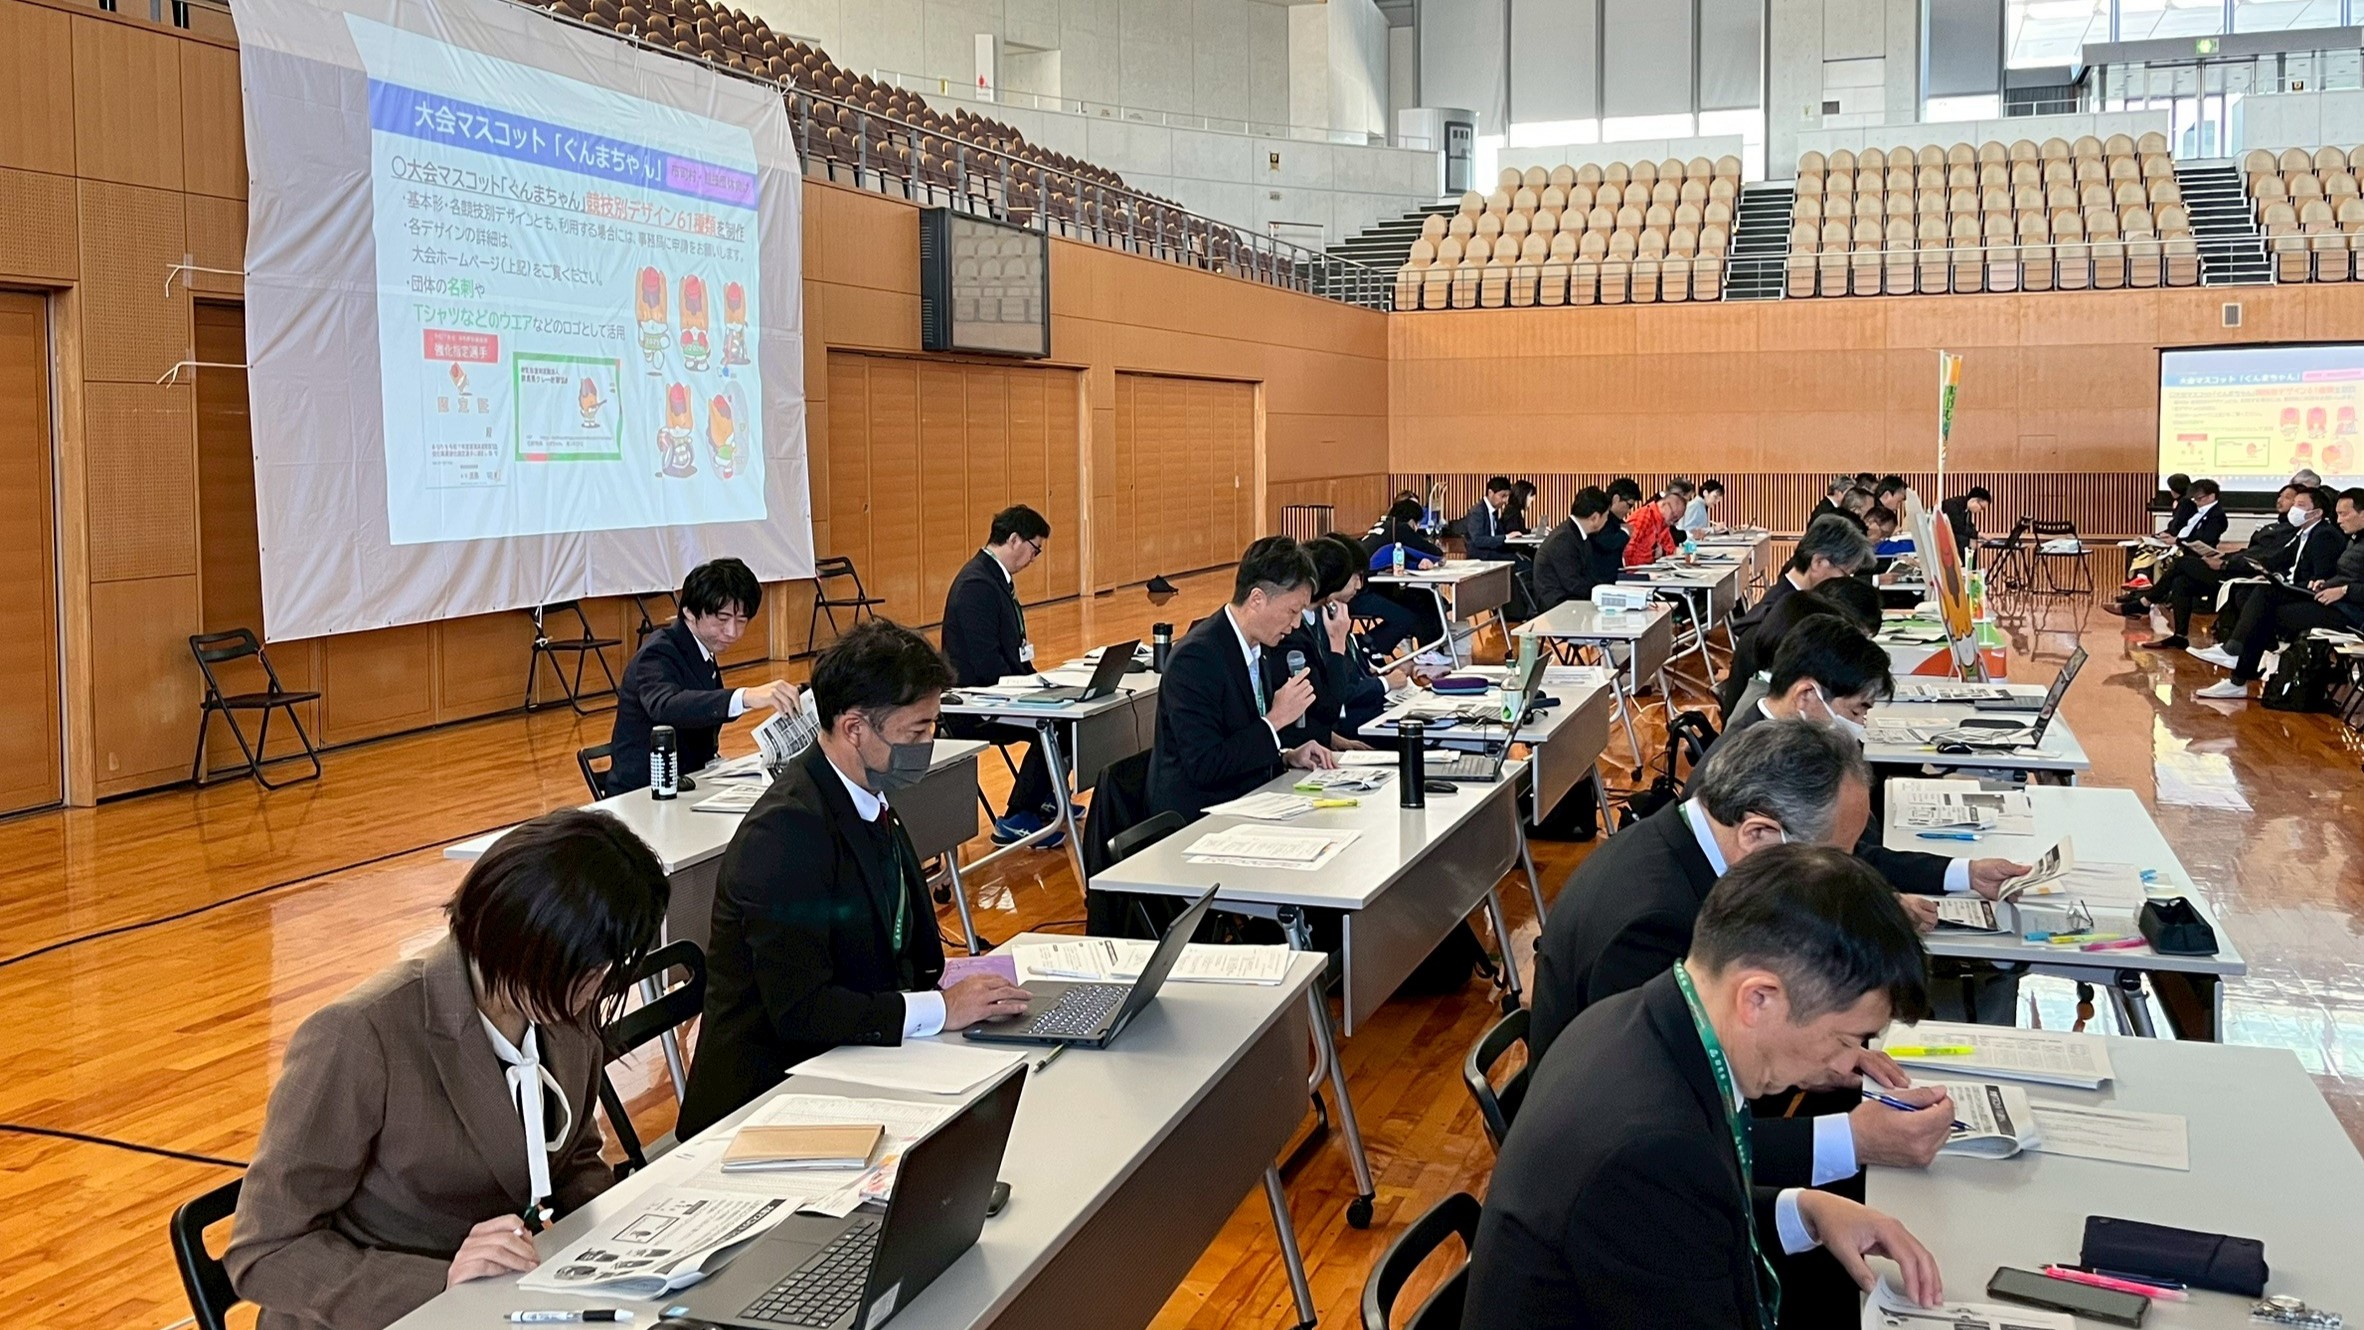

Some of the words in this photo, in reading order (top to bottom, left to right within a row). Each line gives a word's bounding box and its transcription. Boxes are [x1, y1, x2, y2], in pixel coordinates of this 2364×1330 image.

[415, 101, 662, 181] 大会マスコット「ぐんまちゃん」
